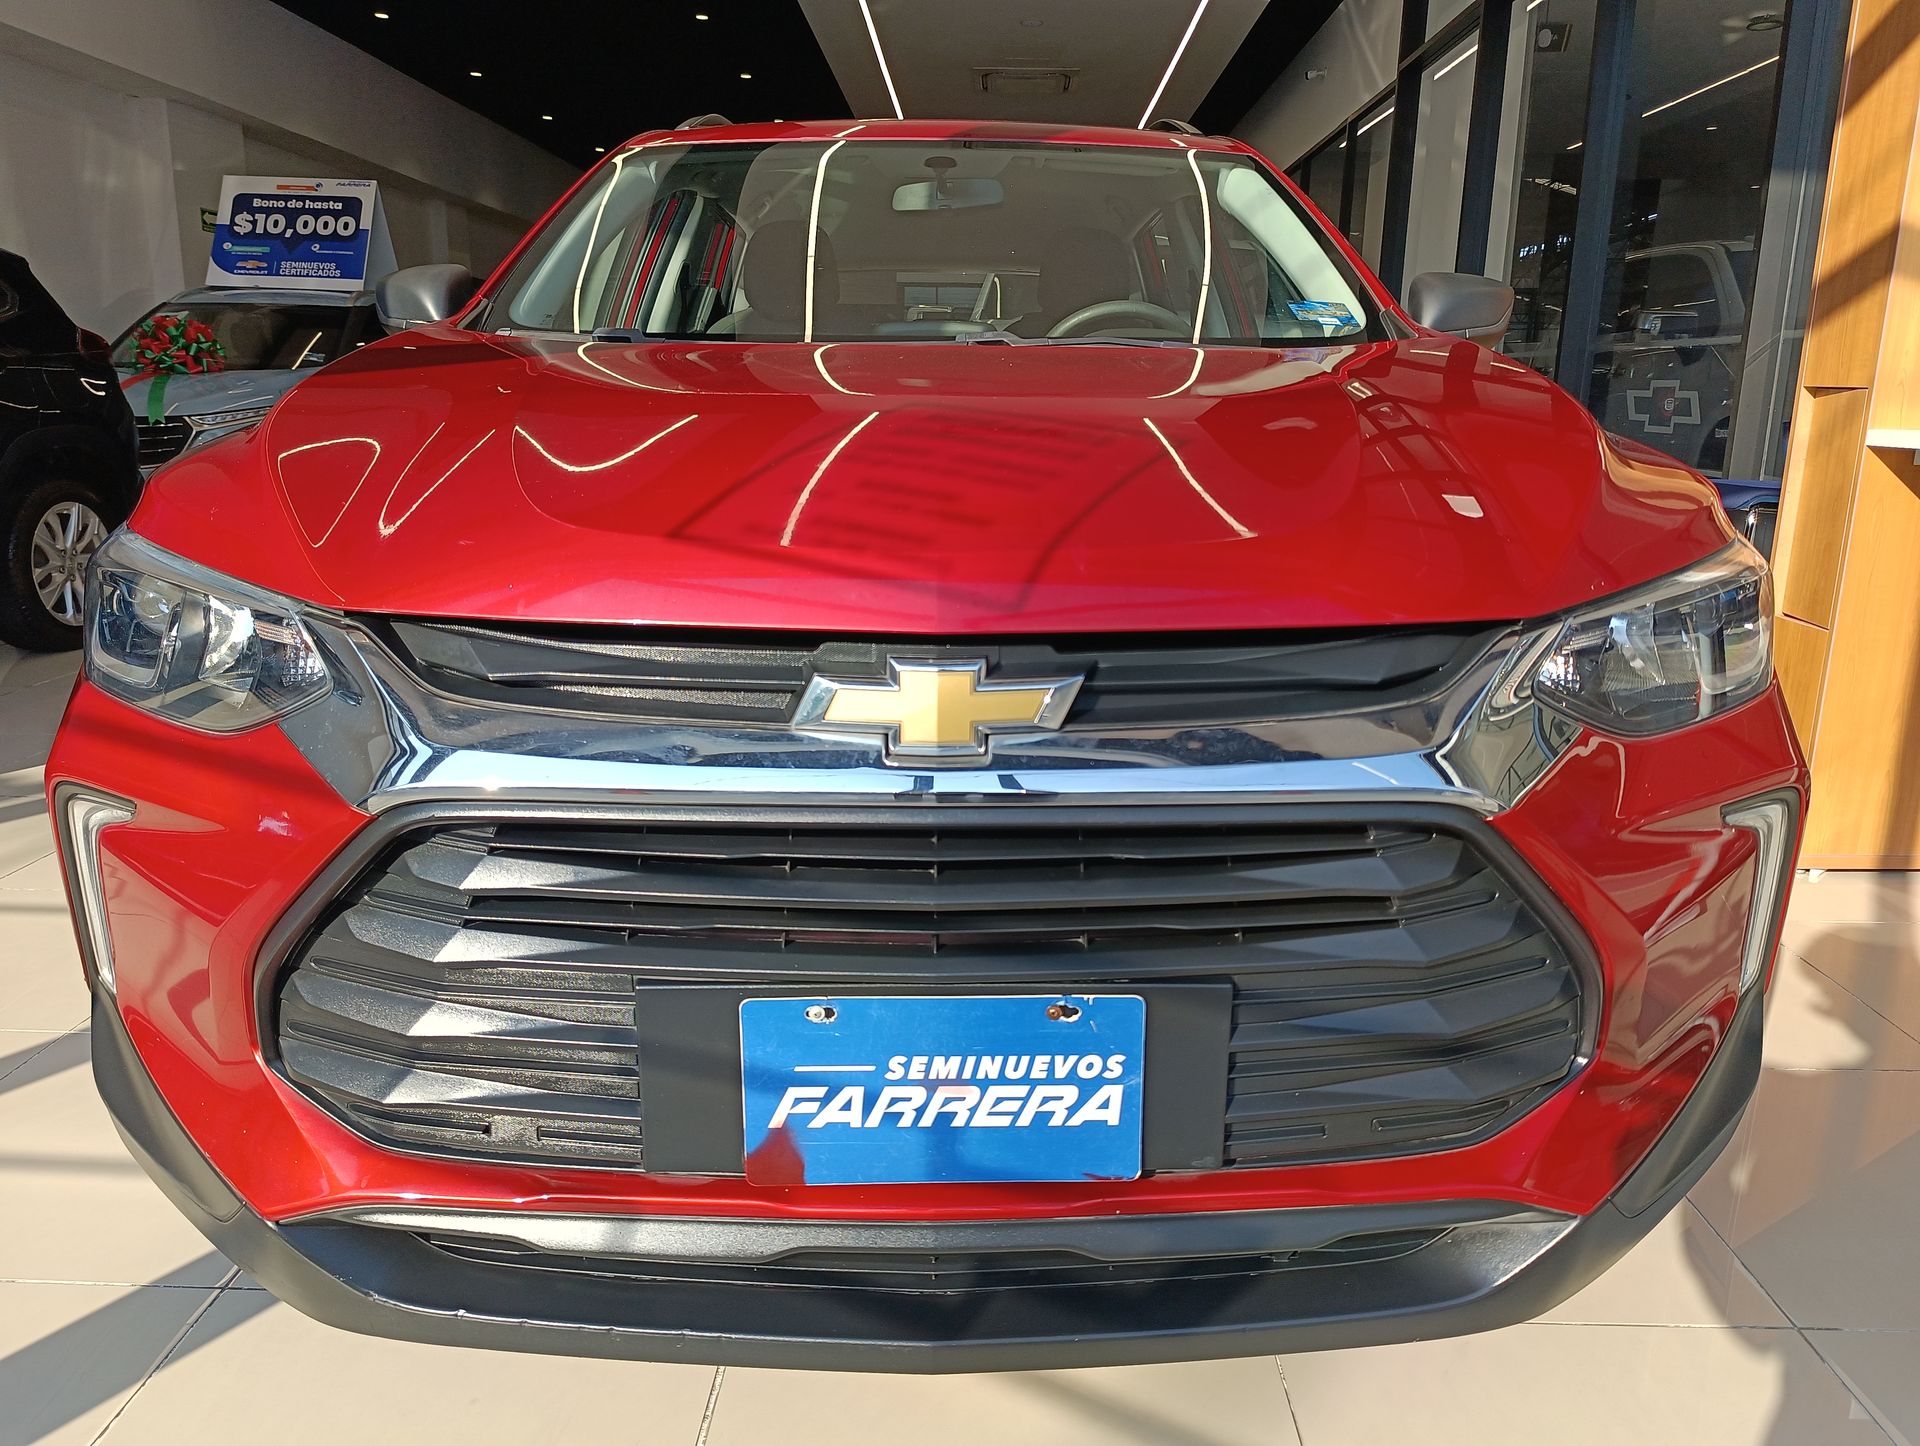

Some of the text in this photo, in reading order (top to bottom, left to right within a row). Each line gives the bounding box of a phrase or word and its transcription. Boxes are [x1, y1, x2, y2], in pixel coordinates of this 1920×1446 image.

[252, 198, 343, 210] Bono de hasta
[233, 212, 356, 238] $10,000
[279, 268, 341, 277] CERTIFICADOS
[280, 261, 336, 270] SEMINUEVOS
[884, 1054, 1127, 1082] SEMINUEVOS
[767, 1084, 1125, 1129] FARRERA
